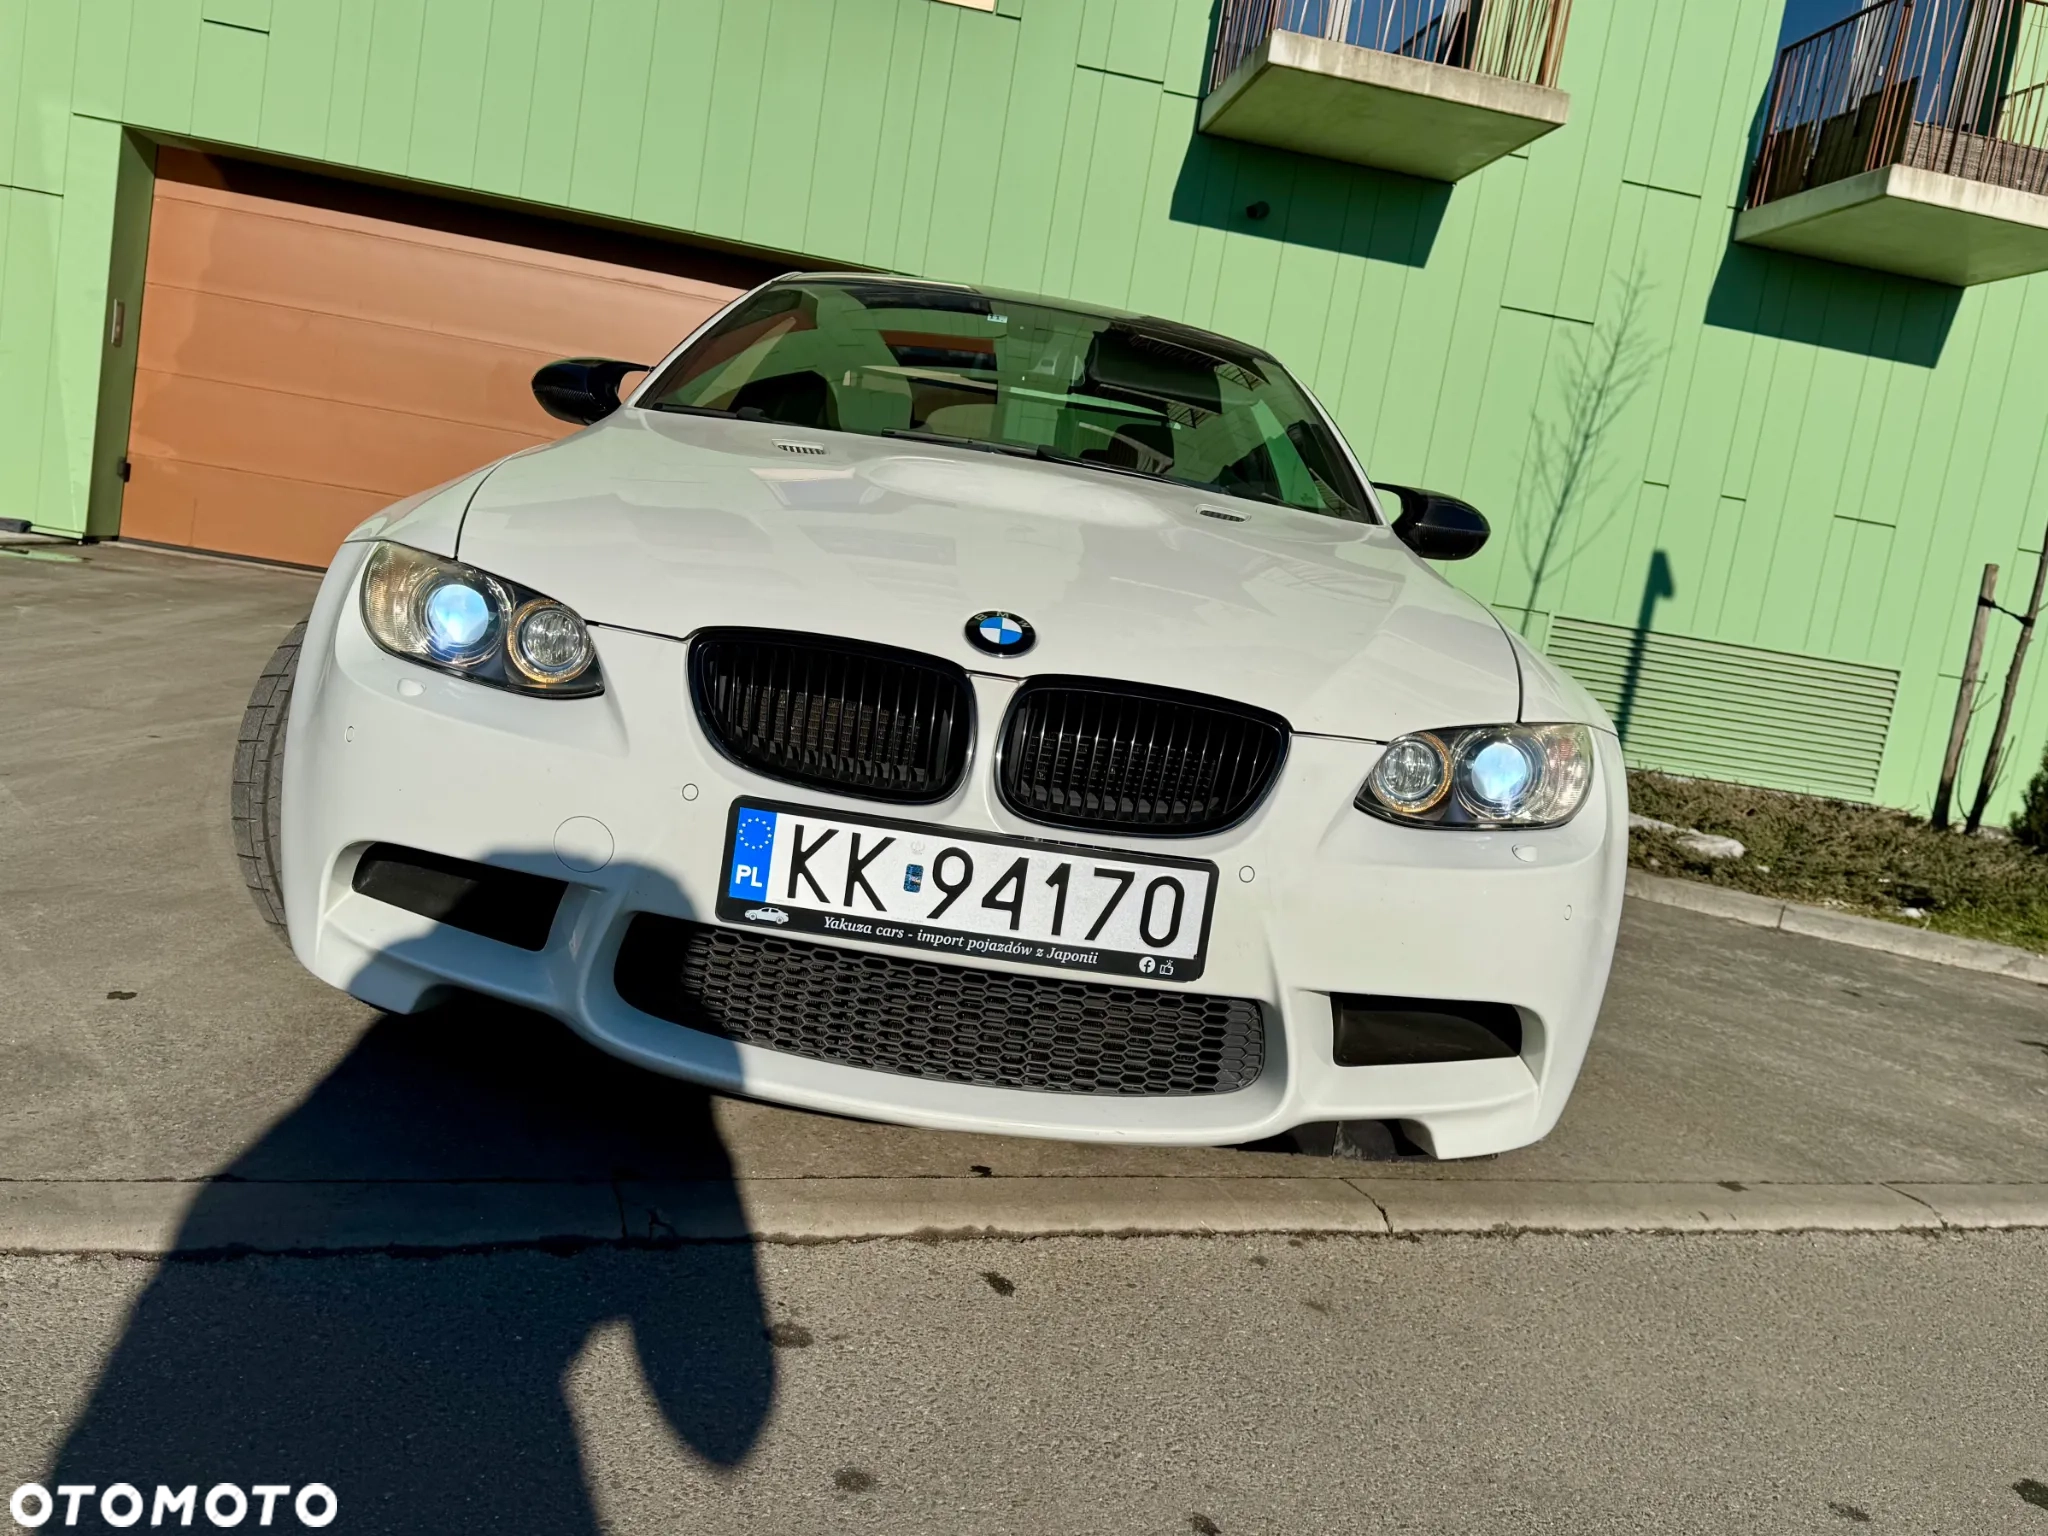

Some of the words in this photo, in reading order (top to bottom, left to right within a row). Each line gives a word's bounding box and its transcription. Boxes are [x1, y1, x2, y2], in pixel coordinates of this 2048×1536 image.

[974, 611, 1030, 628] BMW
[735, 864, 763, 888] PL
[786, 823, 897, 912] KK
[926, 847, 1185, 949] 94170
[823, 916, 873, 934] Yakuza
[875, 927, 905, 939] cars
[917, 929, 965, 947] import
[966, 938, 1033, 956] pojazdów
[1036, 949, 1044, 957] z
[1046, 947, 1099, 964] Japonii
